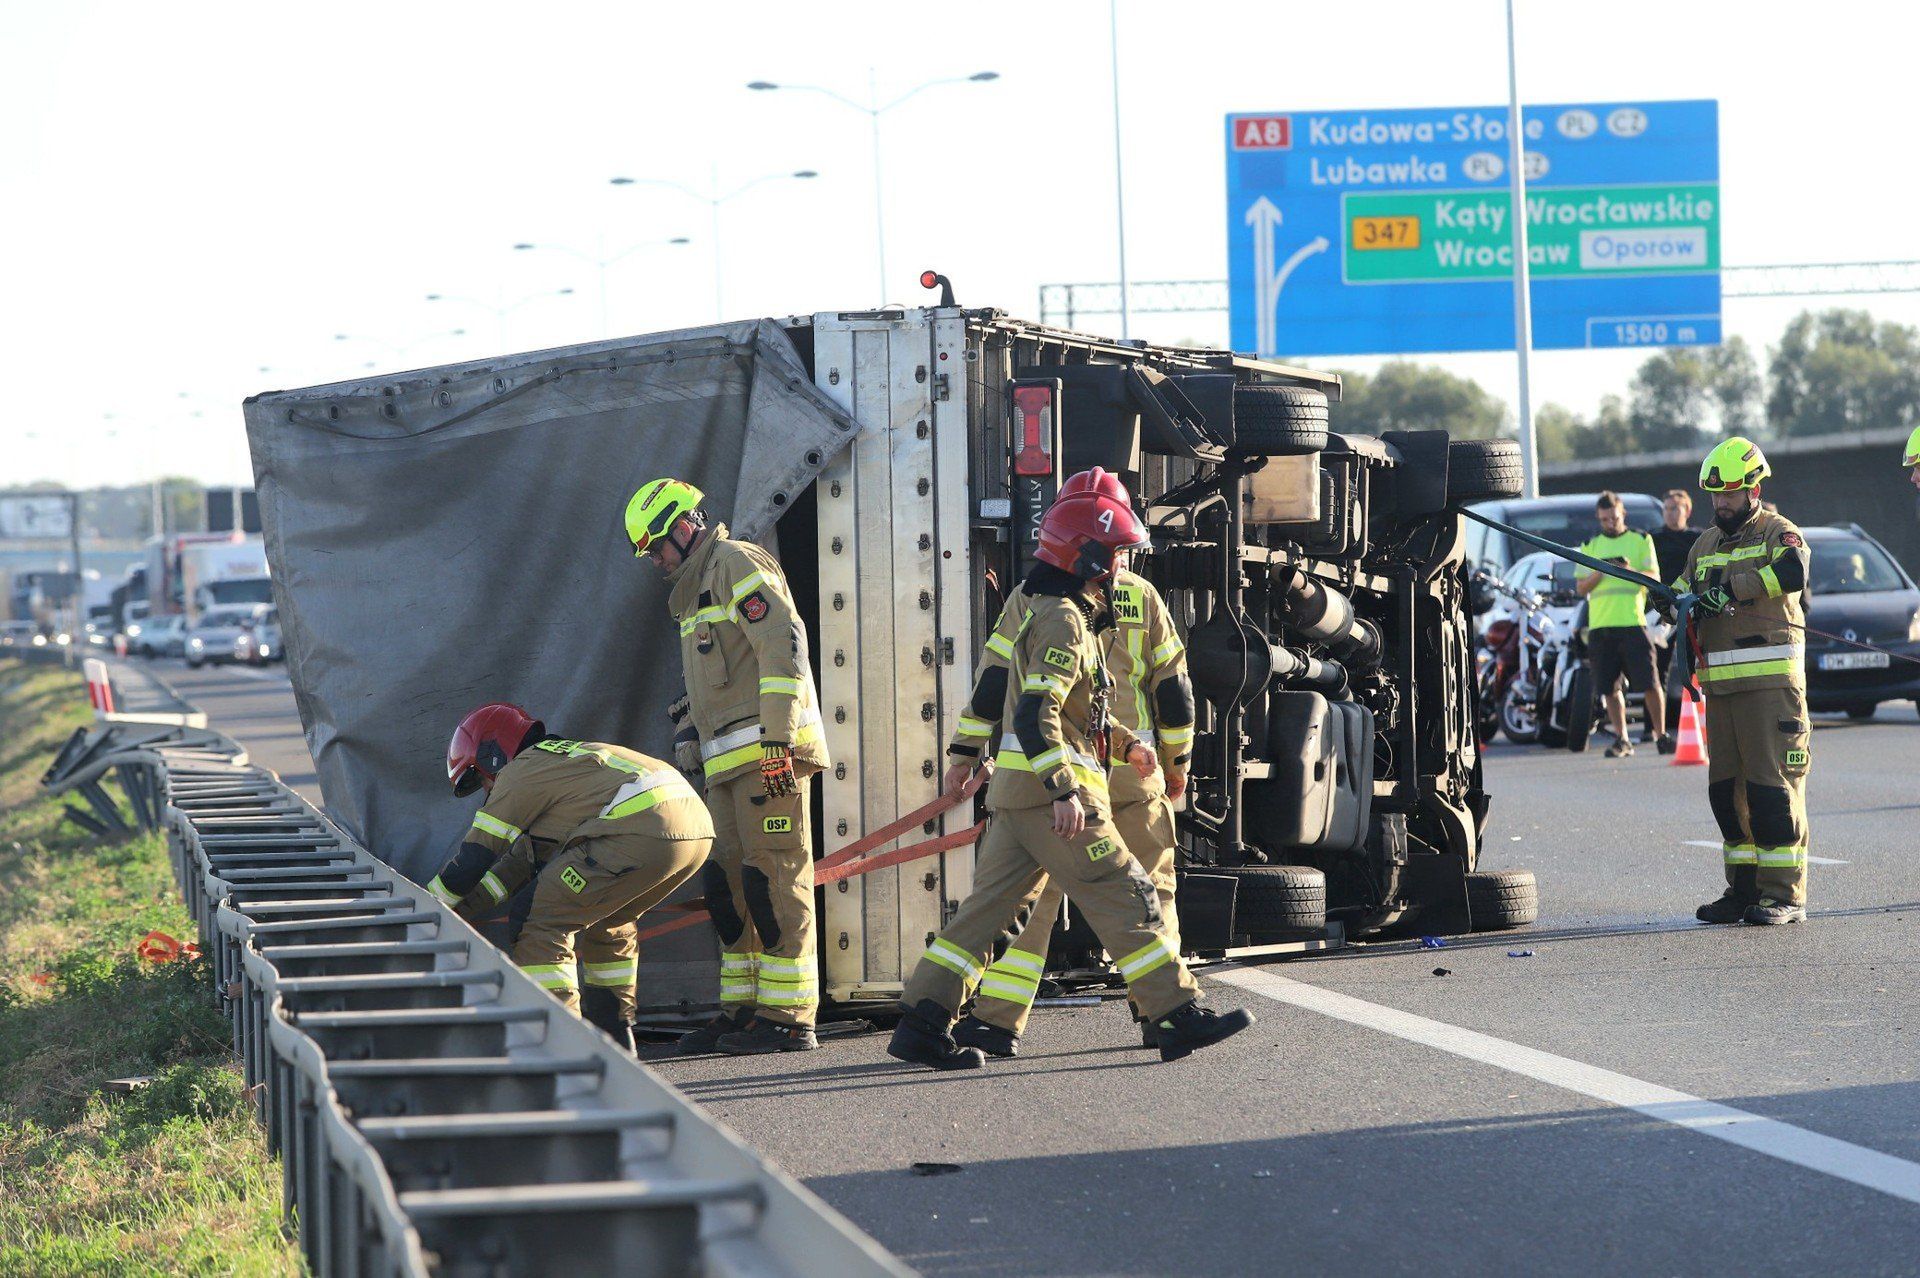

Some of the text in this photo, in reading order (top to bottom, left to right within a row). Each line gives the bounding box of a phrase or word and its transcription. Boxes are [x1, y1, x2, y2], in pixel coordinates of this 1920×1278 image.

[1243, 120, 1282, 145] A8
[1309, 113, 1642, 145] Kudowa-Słoe PL CZ
[1310, 155, 1448, 186] Lubawka
[1471, 157, 1494, 177] PL
[1434, 193, 1714, 234] Kąty Wrocławskie
[1363, 222, 1409, 245] 347
[1434, 239, 1571, 267] Wrocaw
[1592, 235, 1695, 264] Oporów
[1614, 322, 1697, 343] 1500 m
[1030, 479, 1042, 540] DAILY
[1048, 650, 1071, 666] PSP
[1789, 753, 1805, 763] OSP
[767, 819, 788, 831] OSP
[1090, 840, 1110, 858] PSP
[563, 869, 582, 888] PSP
